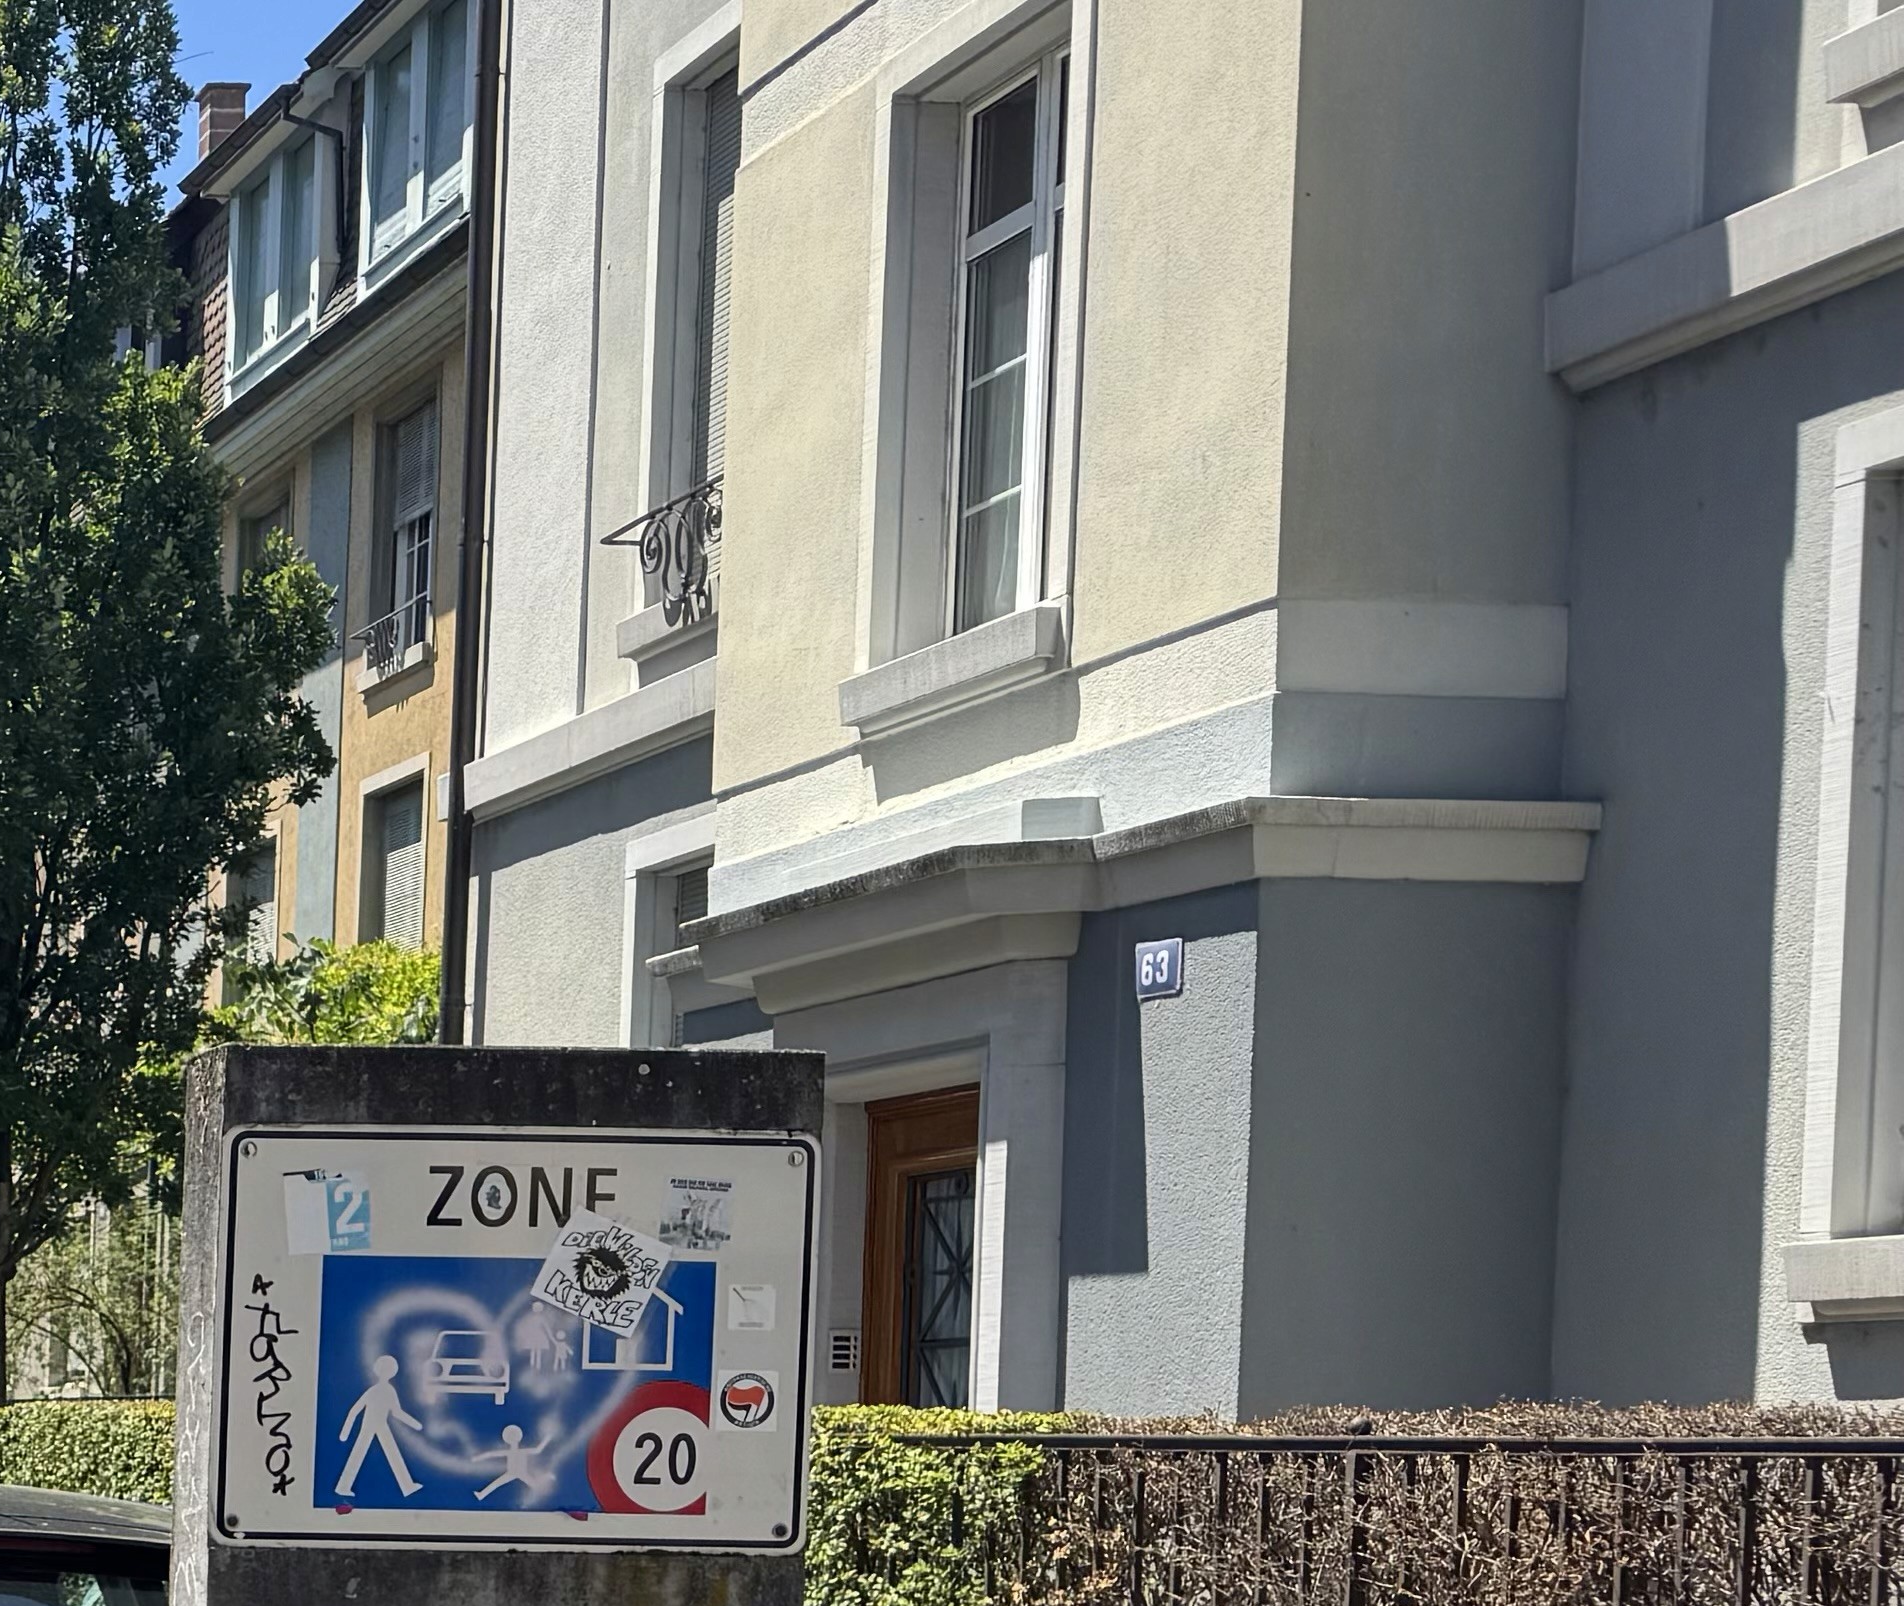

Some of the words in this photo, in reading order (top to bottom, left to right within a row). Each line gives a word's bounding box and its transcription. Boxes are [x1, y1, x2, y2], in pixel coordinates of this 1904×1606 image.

[1141, 949, 1169, 986] 63
[426, 1165, 618, 1229] ZONE
[544, 1269, 644, 1329] KERLE
[633, 1431, 697, 1486] 20
